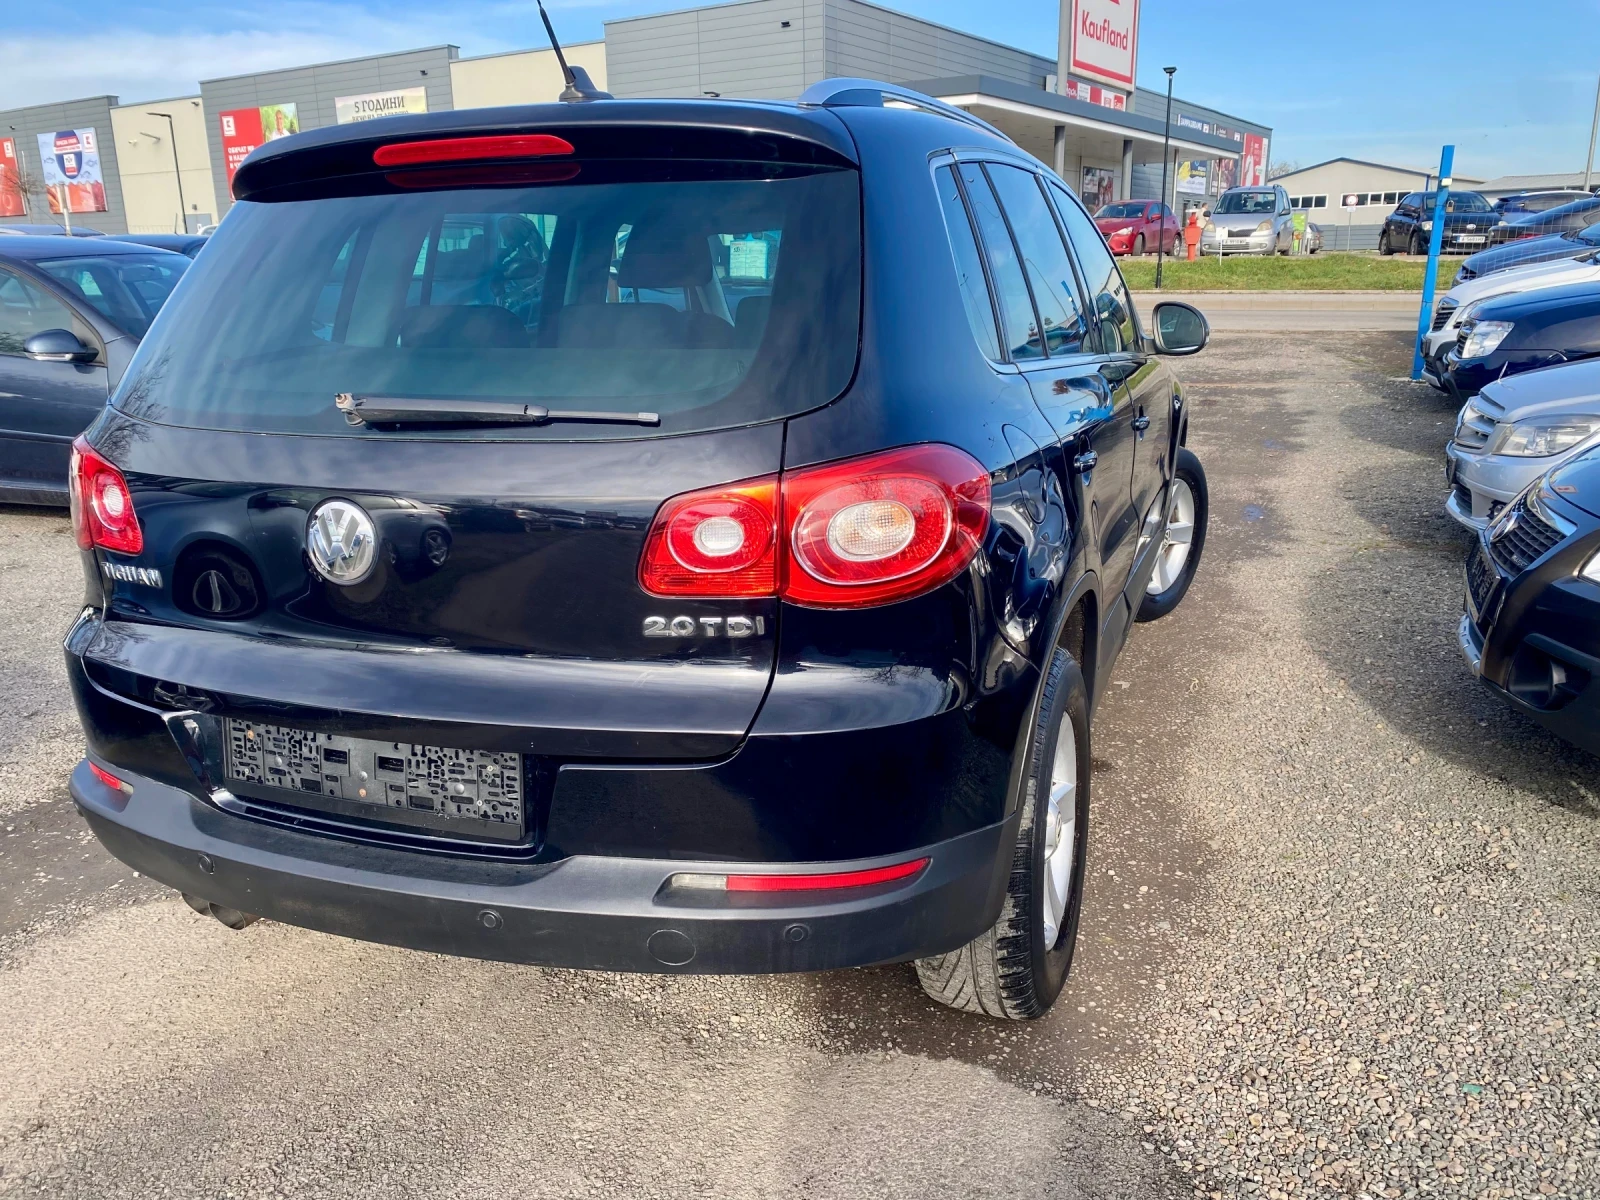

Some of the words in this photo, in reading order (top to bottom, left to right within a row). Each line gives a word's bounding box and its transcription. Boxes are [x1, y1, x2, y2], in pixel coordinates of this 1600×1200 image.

[1081, 10, 1128, 50] Kaufland
[354, 101, 360, 113] 5
[362, 96, 405, 112] ГОДИНИ
[699, 615, 765, 638] TDI
